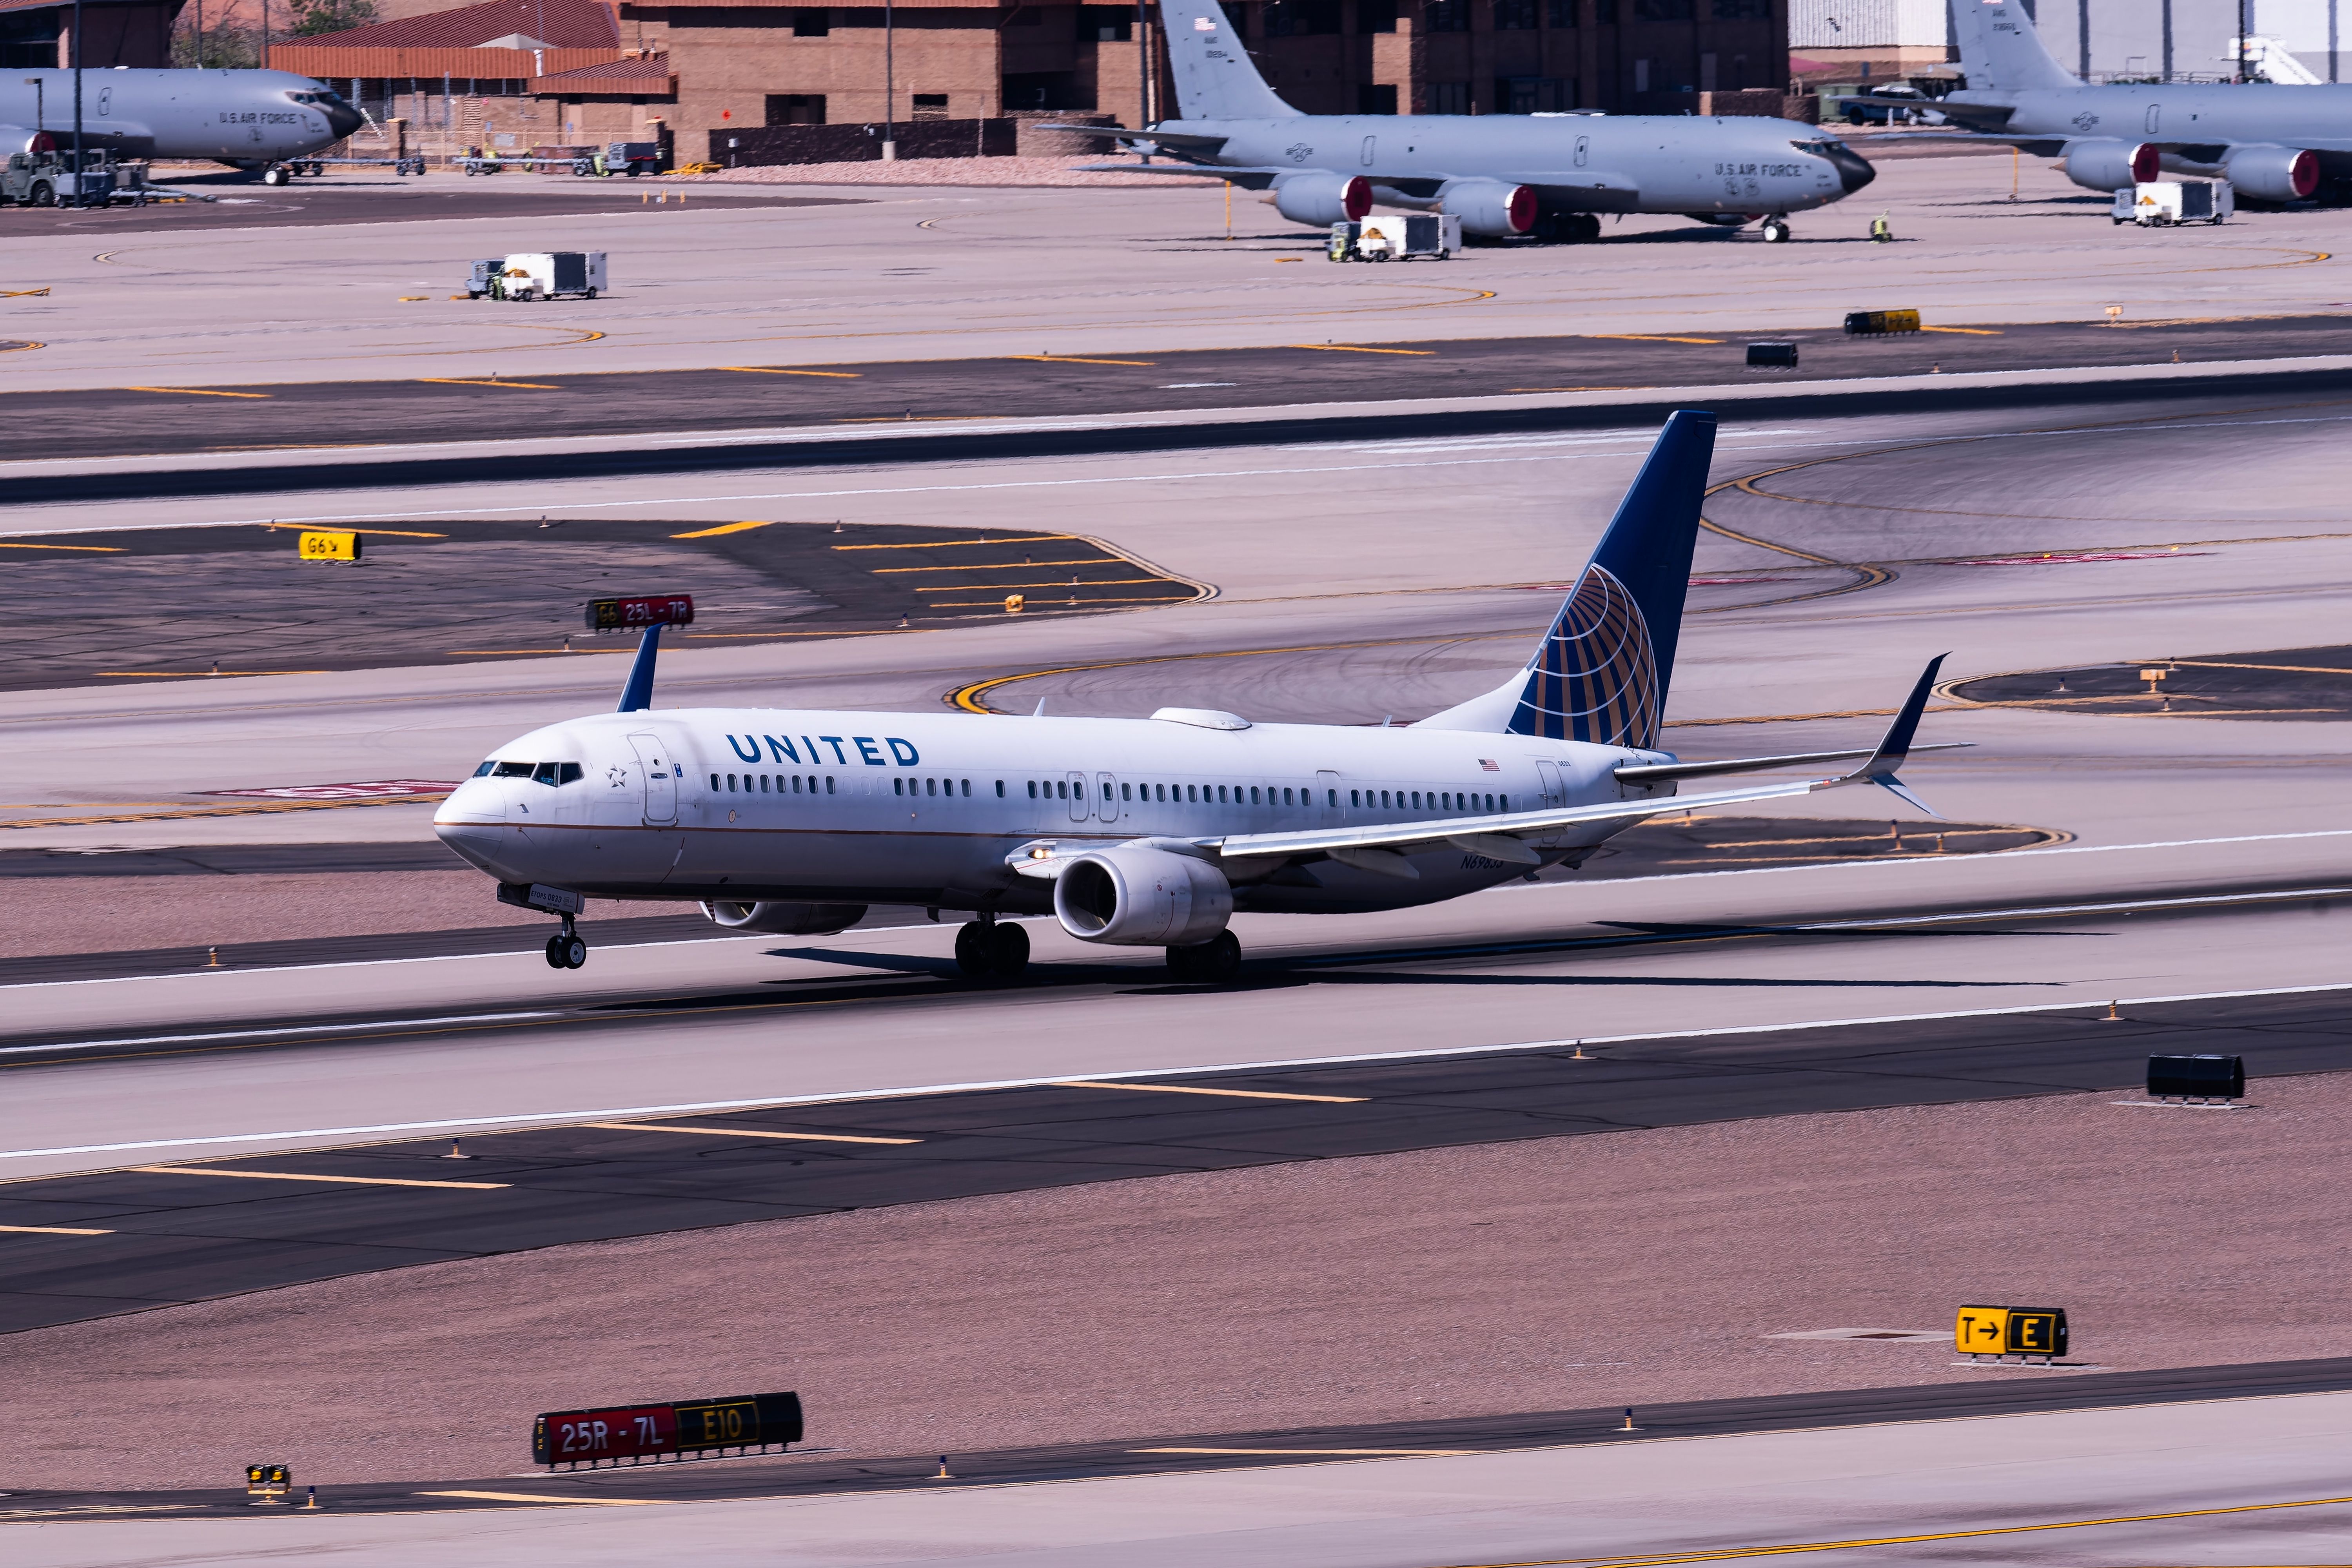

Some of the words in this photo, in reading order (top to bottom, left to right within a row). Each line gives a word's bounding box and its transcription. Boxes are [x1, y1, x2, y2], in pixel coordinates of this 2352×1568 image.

[260, 113, 297, 124] FORCE
[1738, 163, 1758, 176] AIR
[1761, 163, 1802, 177] FORCE
[308, 537, 326, 553] G6
[626, 603, 654, 621] 25L
[668, 601, 688, 619] 7R
[725, 734, 919, 766] UNITED
[531, 890, 546, 900] ETOPS
[548, 894, 562, 903] 0833
[1962, 1316, 1976, 1344] T
[2022, 1318, 2039, 1347] E
[561, 1420, 608, 1452] 25R
[633, 1416, 664, 1446] 7L
[703, 1408, 742, 1441] E10
